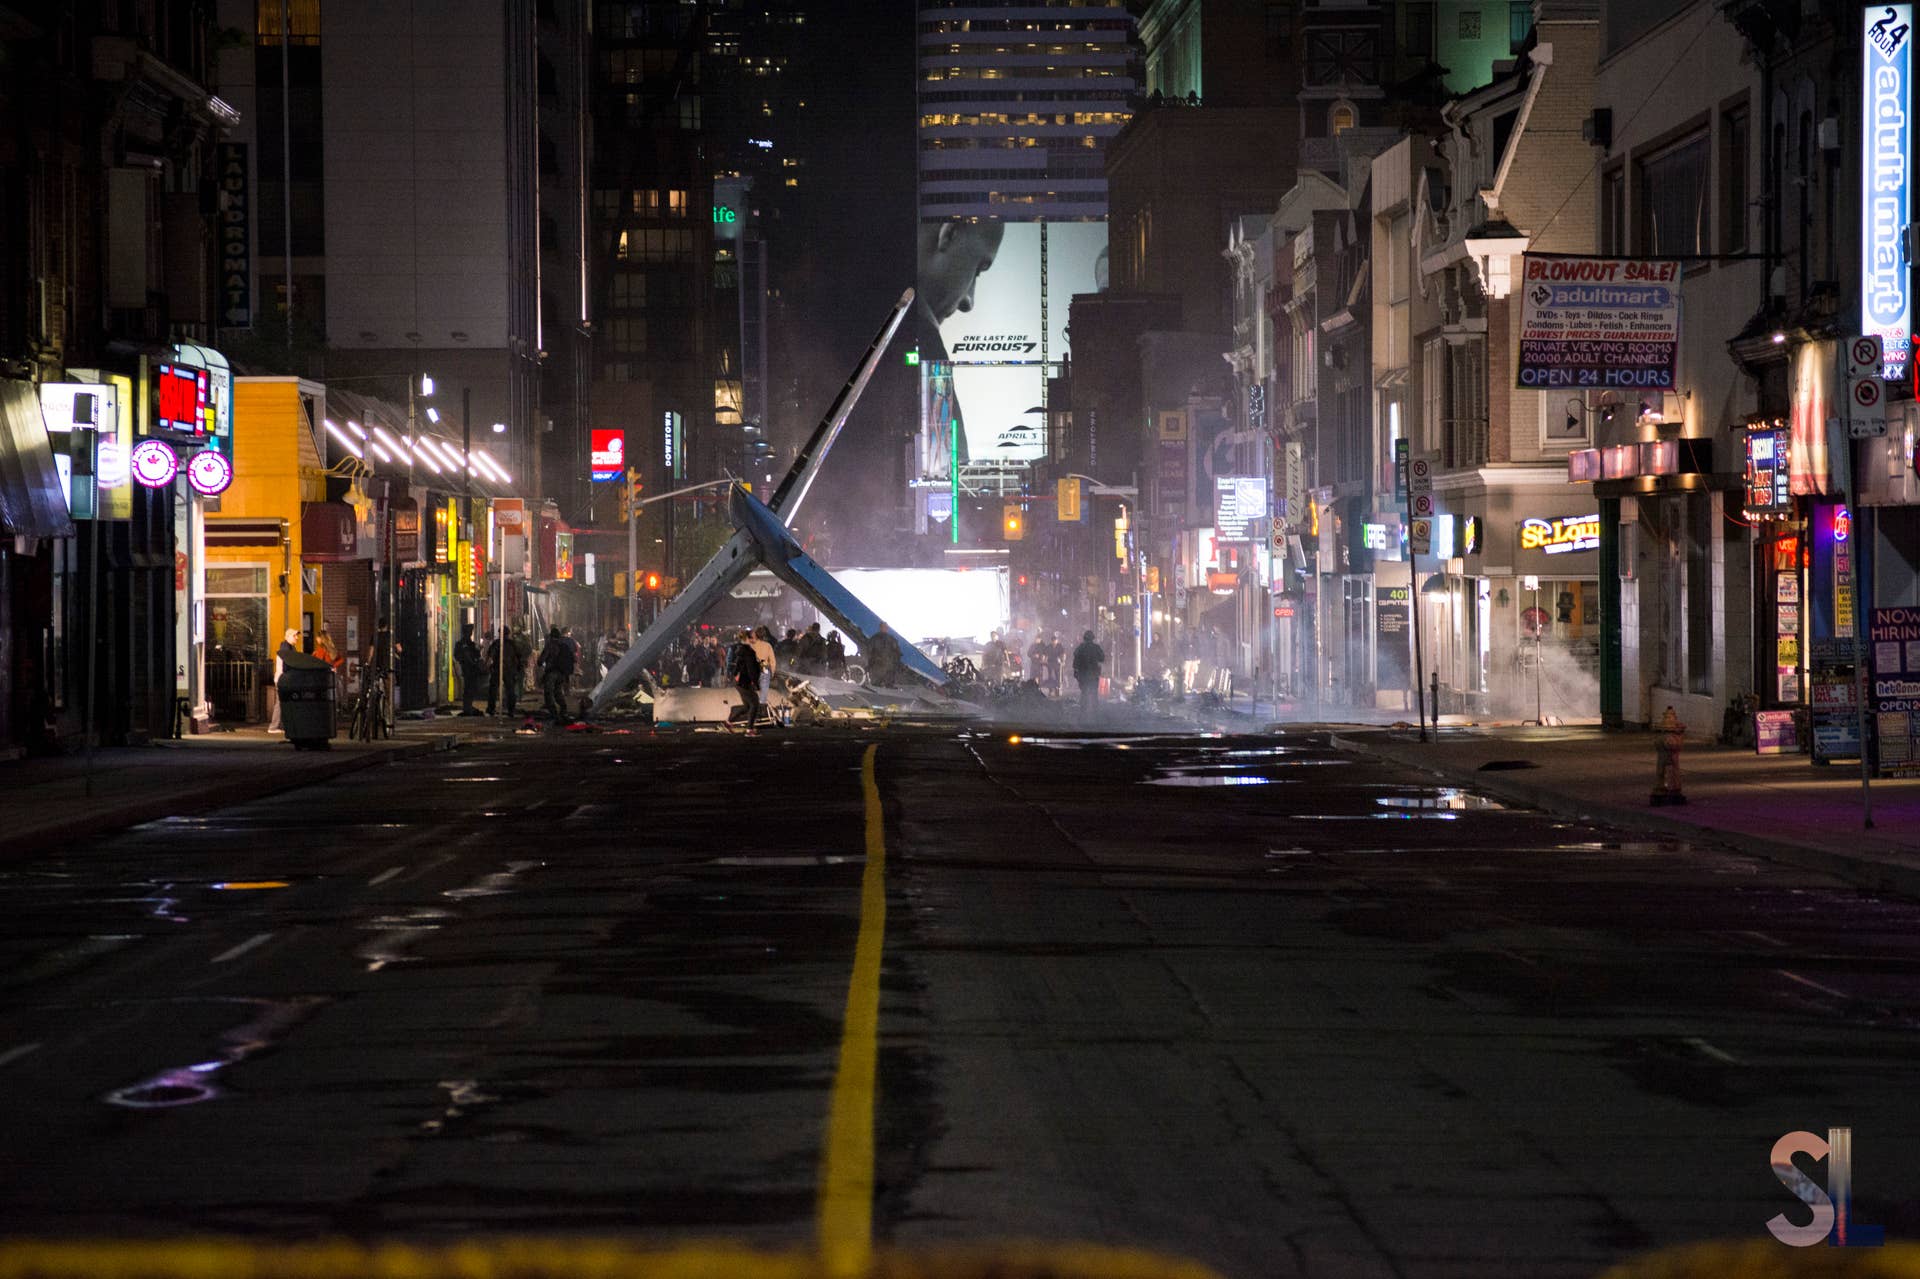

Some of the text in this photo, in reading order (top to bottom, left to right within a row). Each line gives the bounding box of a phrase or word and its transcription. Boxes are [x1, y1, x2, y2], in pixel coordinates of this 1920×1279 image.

[1880, 7, 1909, 45] 24
[1868, 25, 1895, 57] HOUR
[713, 206, 735, 223] ife
[225, 144, 245, 304] LAUNDROMAT
[1528, 260, 1678, 282] BLOWOUT SALE!
[1531, 286, 1550, 303] 24
[1555, 288, 1661, 304] adultmart
[1536, 311, 1663, 321] DVDs Toys Dildos Cock Rings
[1527, 320, 1672, 331] Condoms Lubes Fetish Enhancers
[1523, 331, 1674, 340] LOWEST PRICES GUARANTEED!
[1522, 342, 1672, 353] PRIVATE VIEWING ROOMS
[1564, 352, 1599, 363] ADULT
[1604, 353, 1669, 364] CHANNELS
[1883, 351, 1906, 361] WING
[1521, 368, 1670, 384] OPEN 24 HOURS
[1390, 590, 1408, 599] 401
[1275, 608, 1293, 617] OPEN
[1872, 626, 1920, 640] HIRIN
[1880, 700, 1911, 711] OPEN
